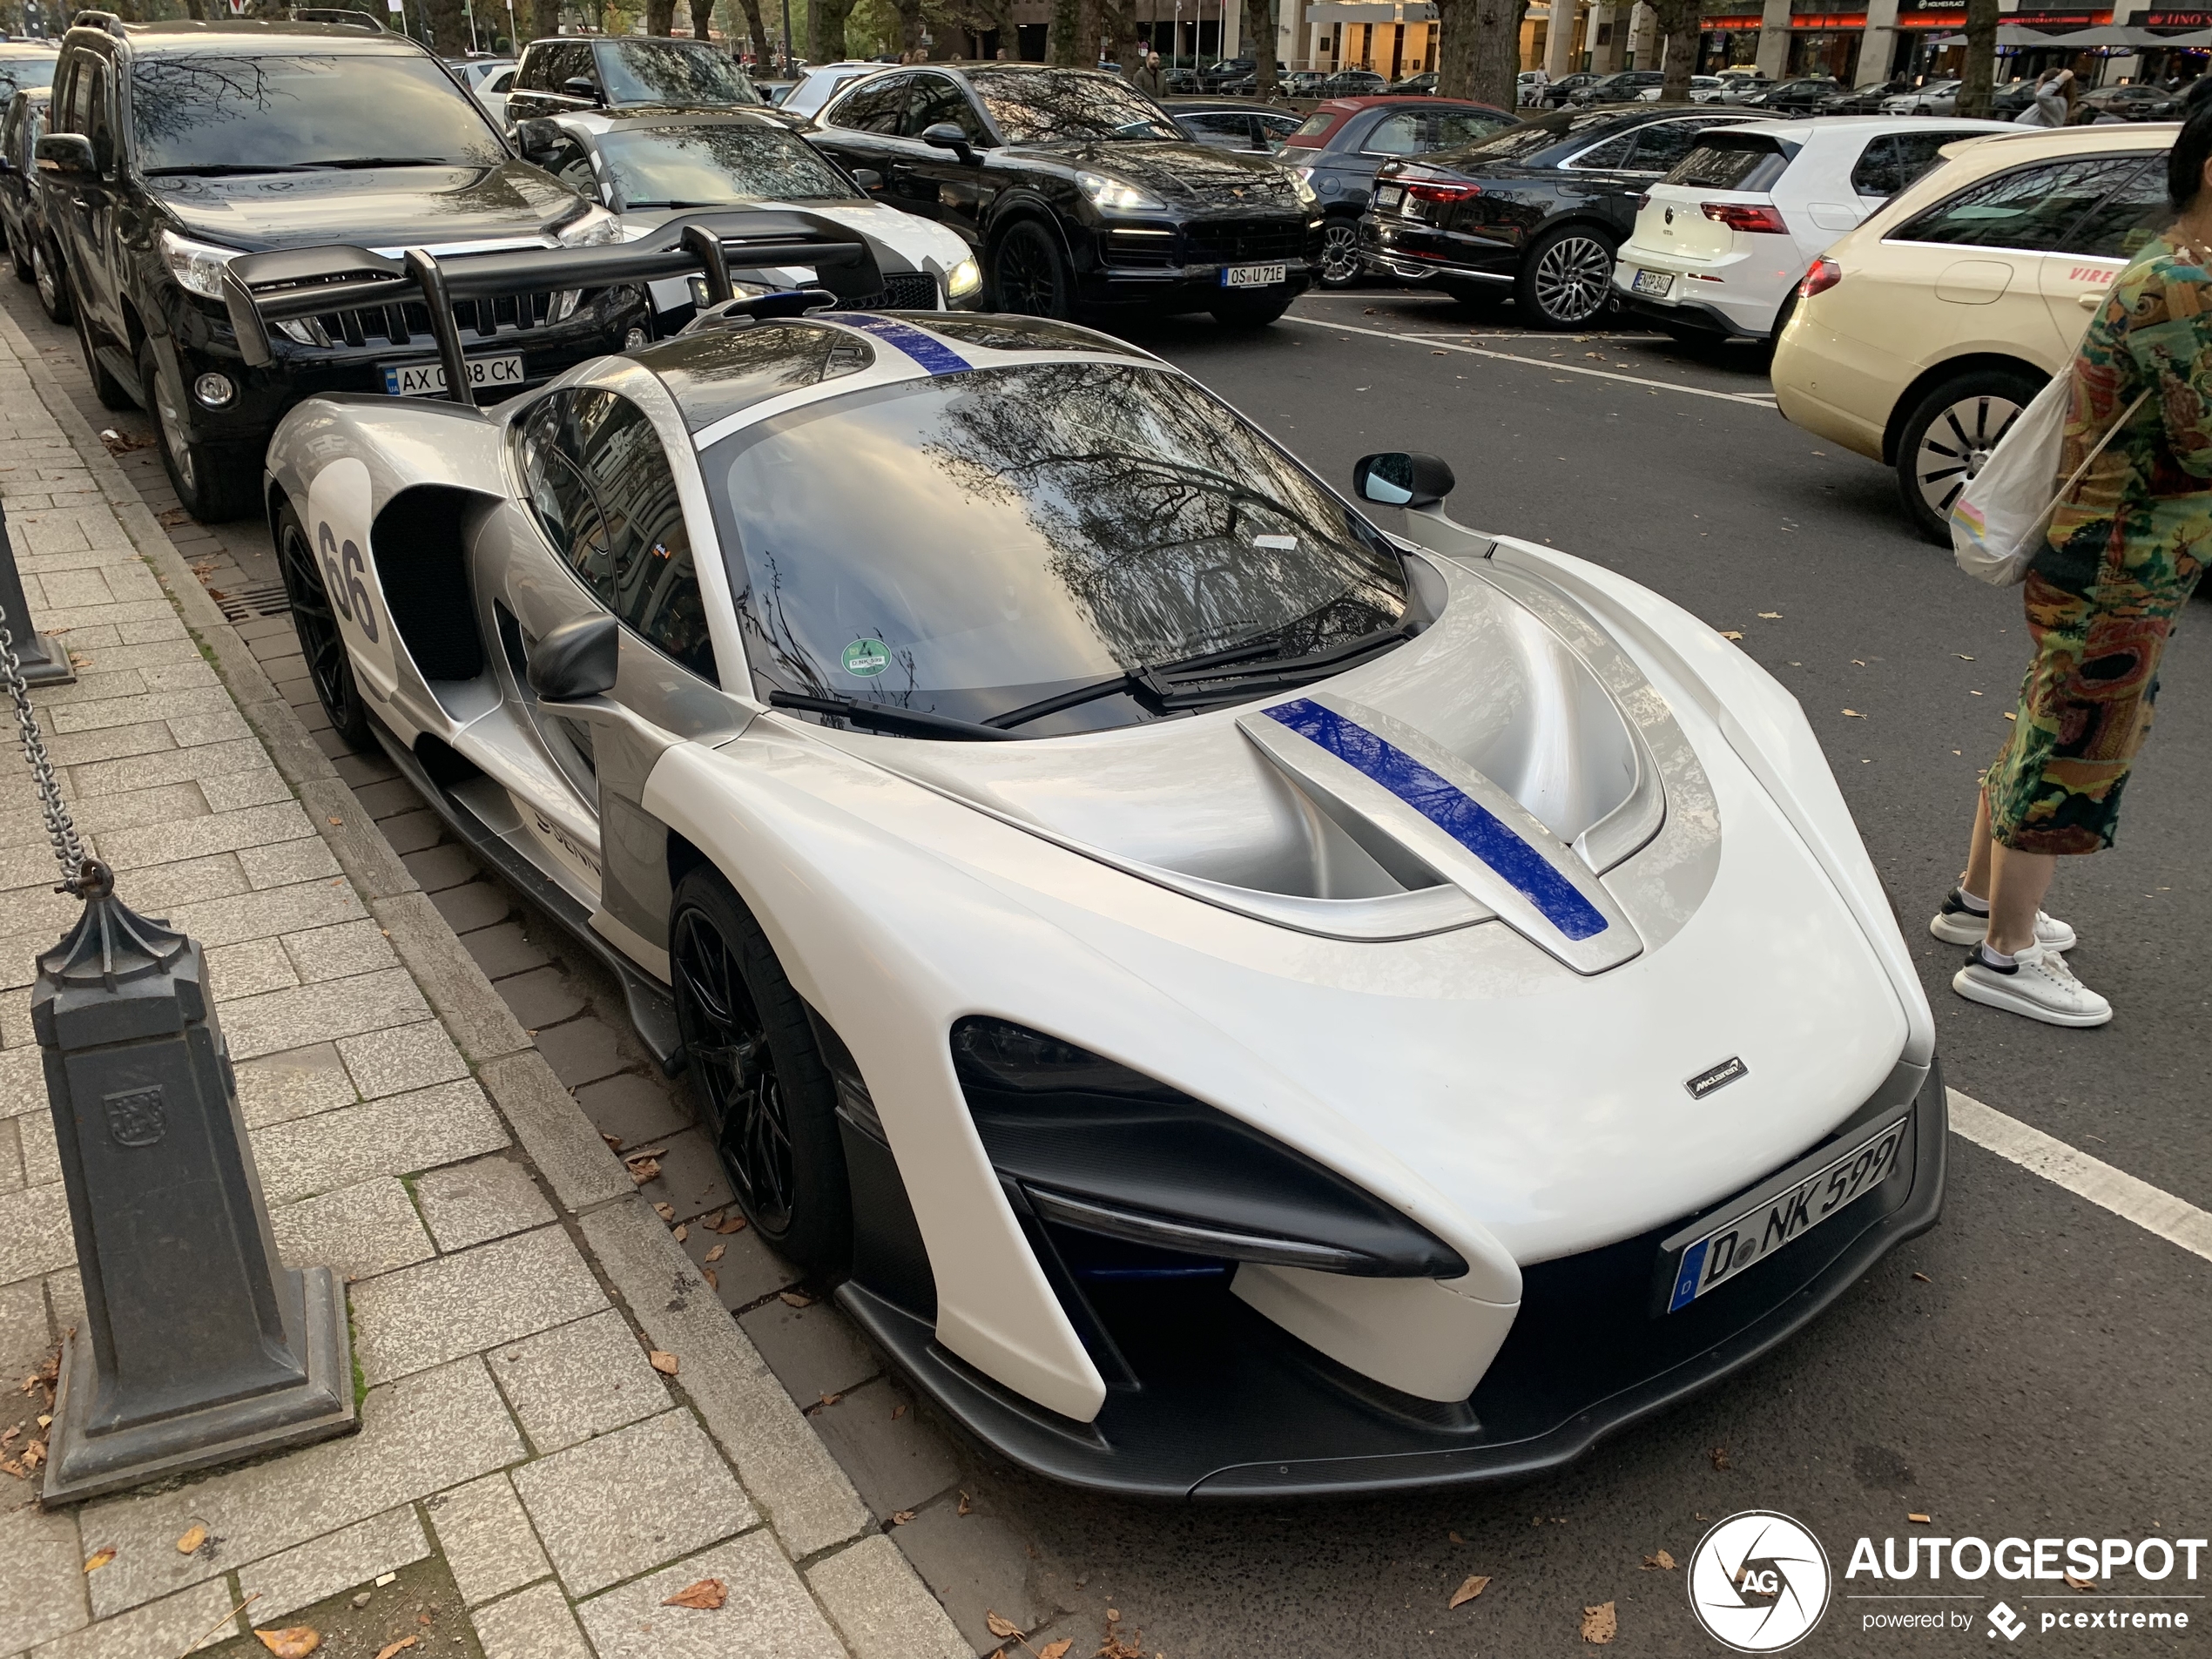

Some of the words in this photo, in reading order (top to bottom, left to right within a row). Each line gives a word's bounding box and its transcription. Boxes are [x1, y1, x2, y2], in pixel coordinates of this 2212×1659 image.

[1231, 269, 1246, 284] OS
[1253, 268, 1261, 282] U
[403, 369, 431, 391] AX
[491, 360, 520, 381] CK
[319, 521, 379, 644] 66
[1696, 1065, 1739, 1092] McLaren
[1703, 1230, 1739, 1288] D
[1760, 1179, 1823, 1254] NK
[1821, 1133, 1897, 1214] 599
